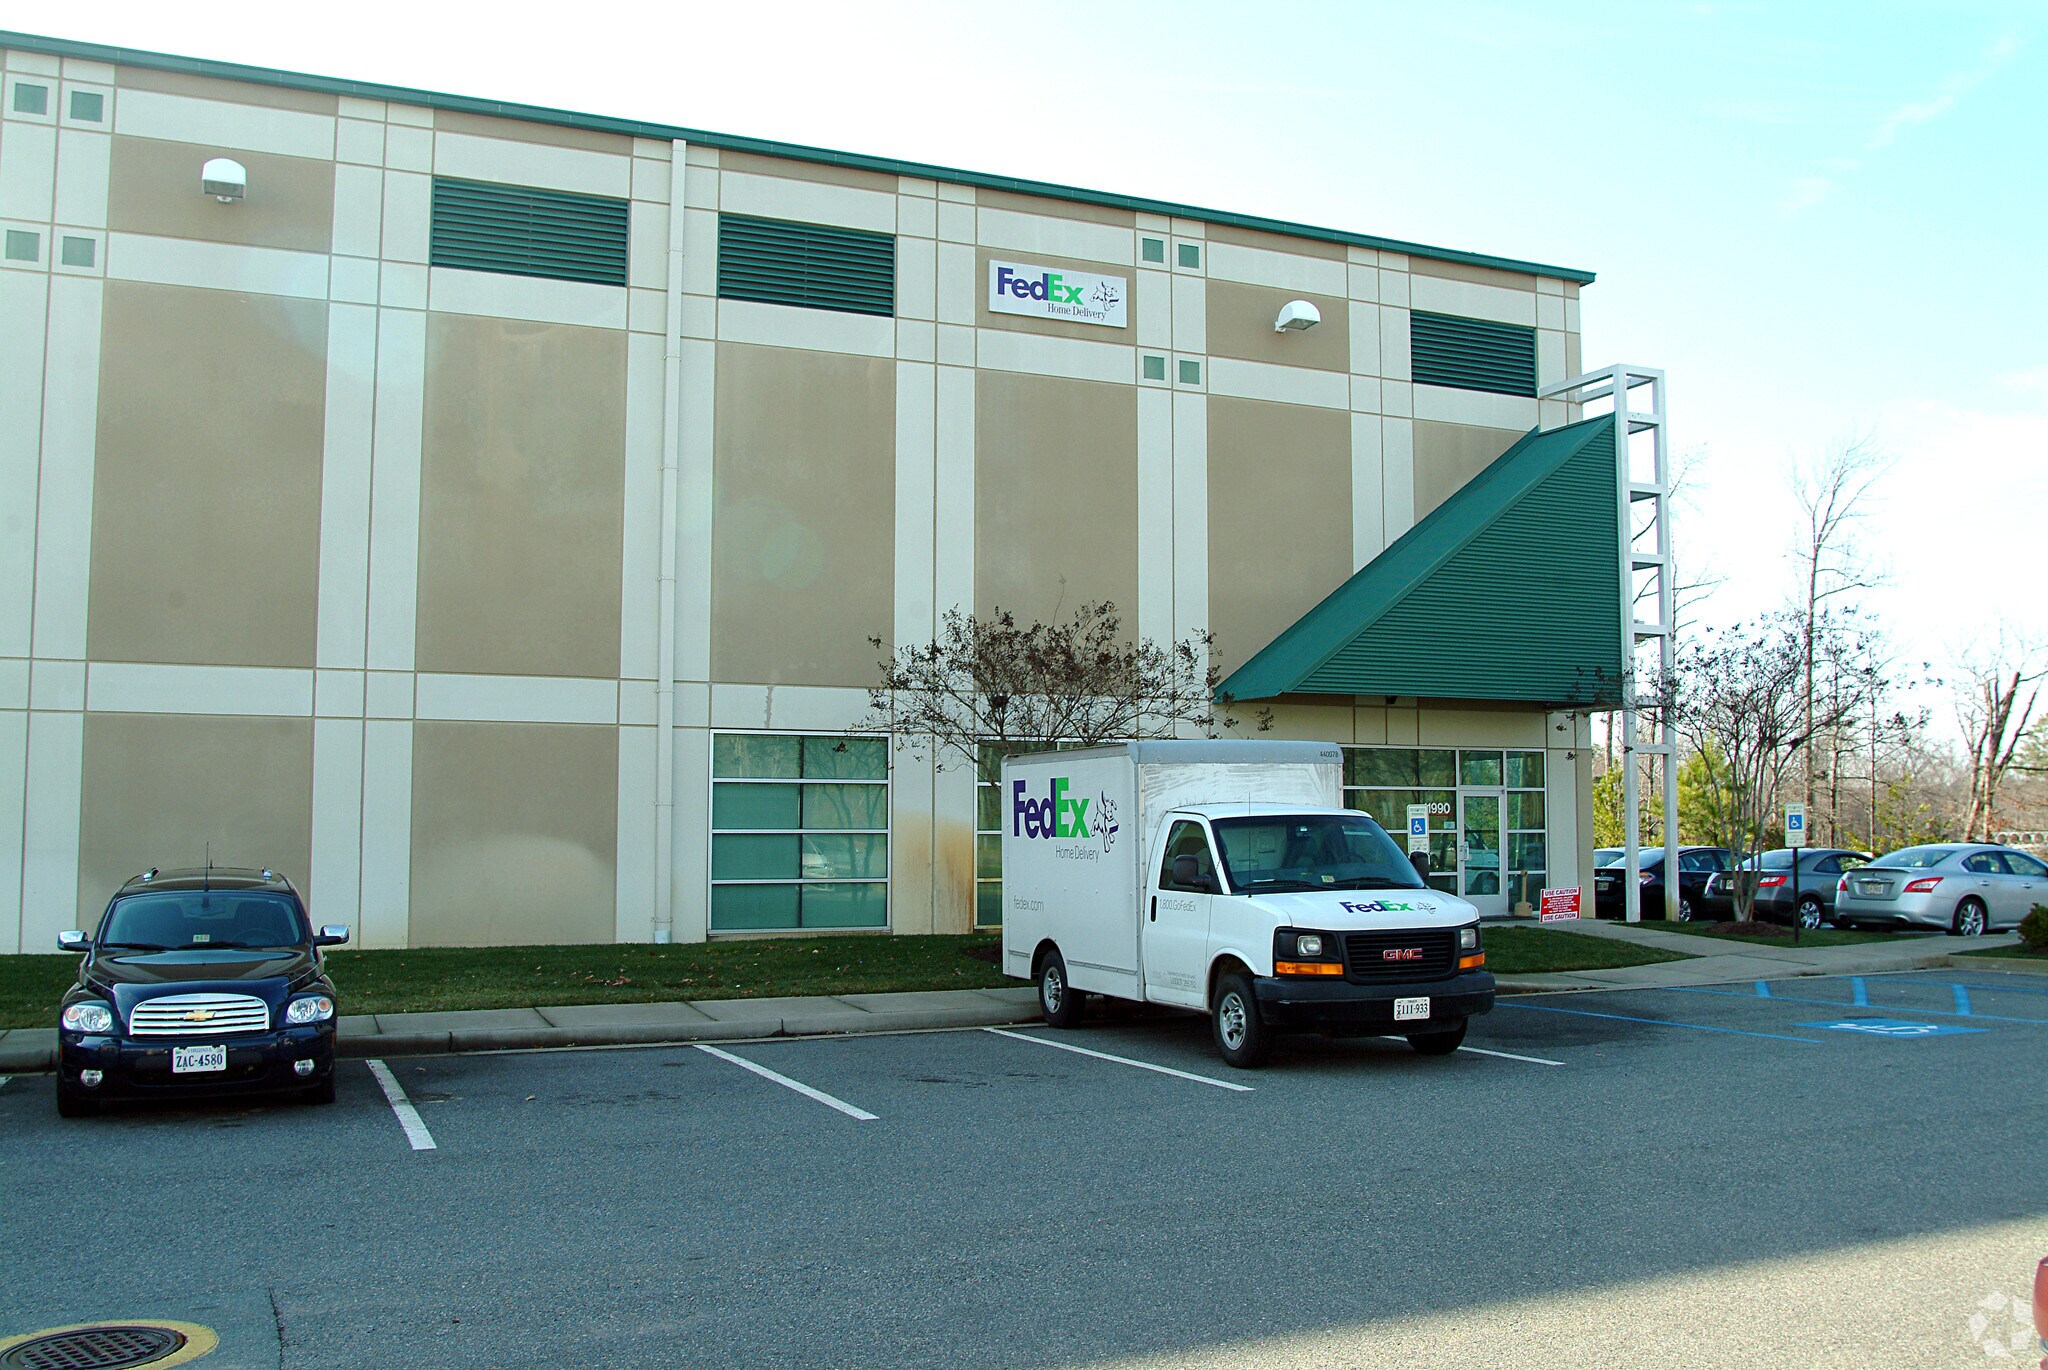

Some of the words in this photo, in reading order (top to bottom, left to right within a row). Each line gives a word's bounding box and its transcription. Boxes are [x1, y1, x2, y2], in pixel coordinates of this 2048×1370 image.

[997, 266, 1084, 305] FedEx
[1048, 303, 1071, 315] Home
[1072, 305, 1107, 321] Delivery
[1013, 777, 1090, 839] FedEx
[1424, 802, 1451, 814] 1990
[1056, 845, 1074, 859] Home
[1075, 845, 1099, 863] Delivery
[1014, 895, 1044, 911] fedex.com
[1339, 900, 1414, 913] FedEx
[1383, 948, 1423, 961] GMC
[176, 1053, 223, 1068] ZAC-4580
